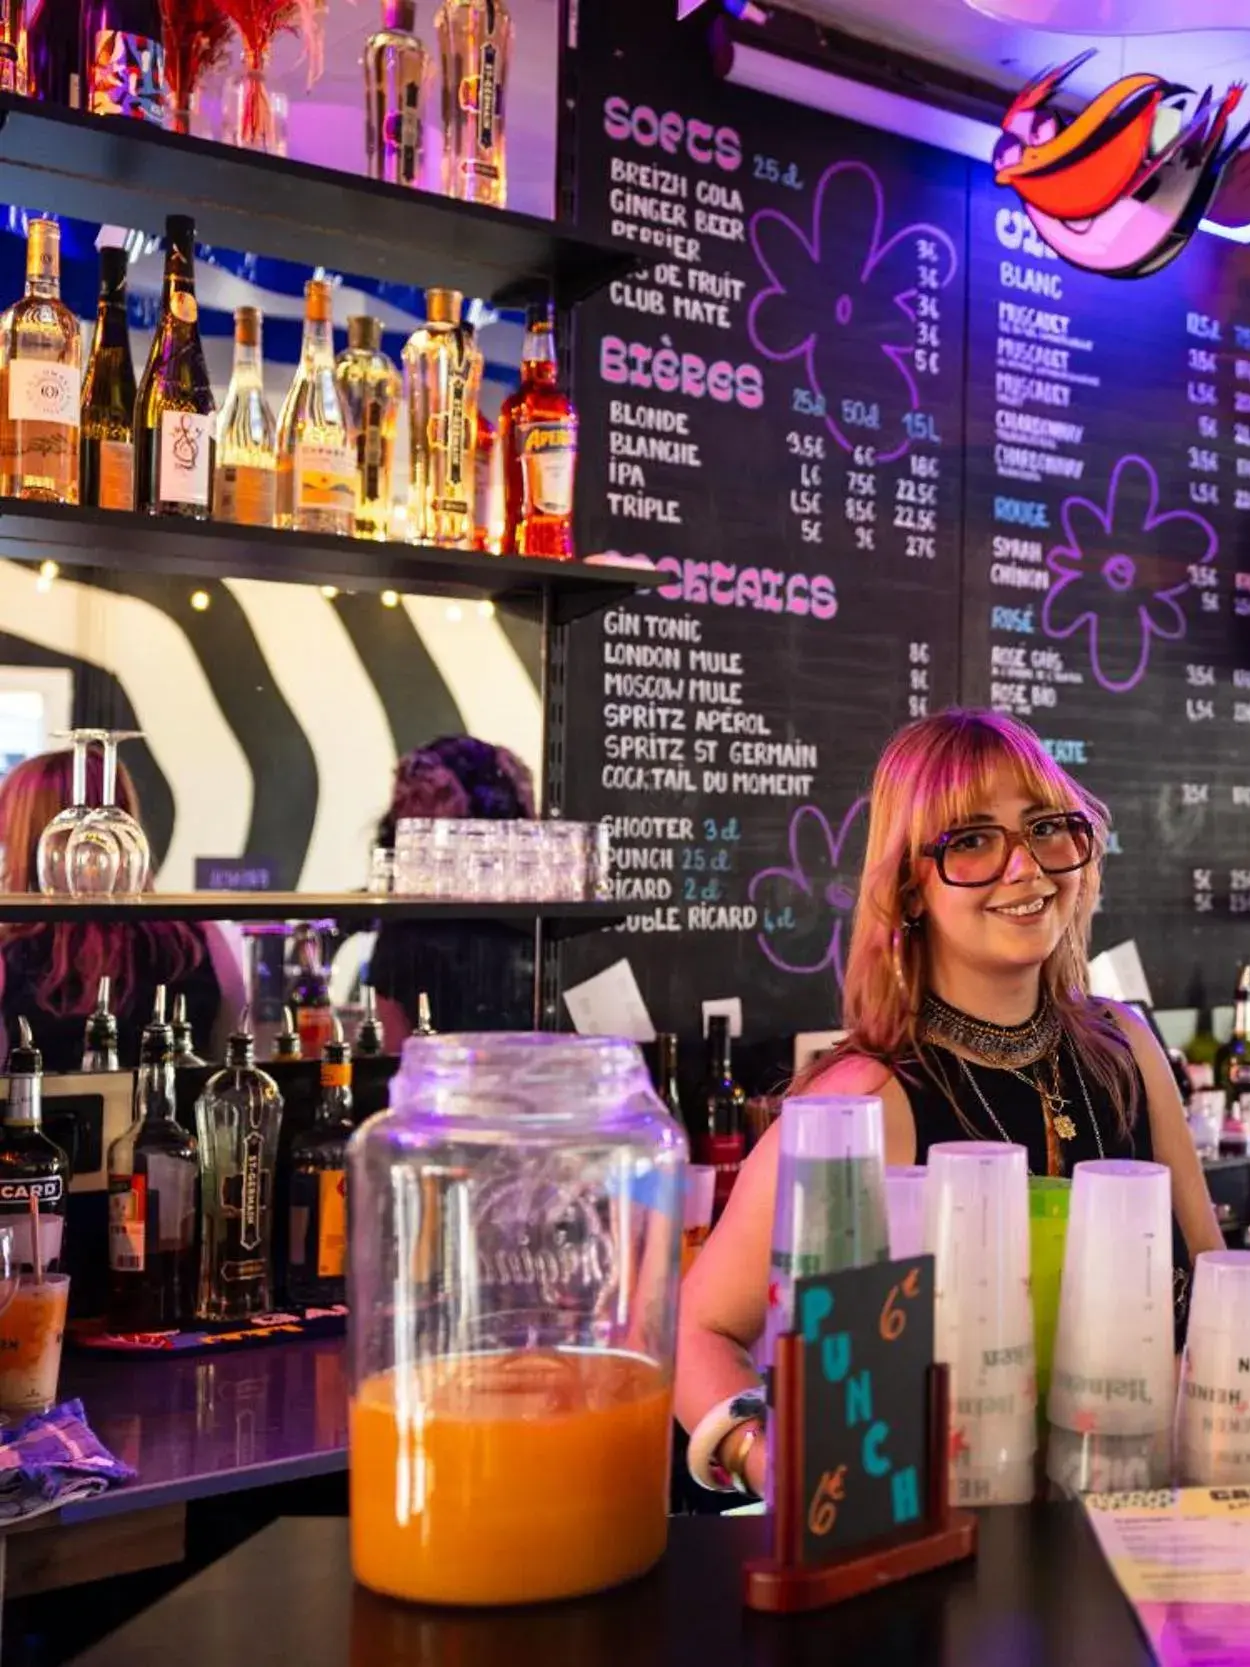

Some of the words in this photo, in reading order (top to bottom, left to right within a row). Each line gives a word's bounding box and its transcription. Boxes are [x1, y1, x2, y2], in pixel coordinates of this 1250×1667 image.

[604, 96, 742, 172] SOFTS
[611, 156, 688, 199] BREIZH
[695, 179, 744, 214] COLA
[610, 187, 688, 229] GINGER
[694, 209, 746, 243] BEER
[654, 263, 683, 289] DE
[687, 271, 746, 302] FRUIT
[1000, 261, 1063, 301] BLANC
[609, 281, 666, 315] CLUB
[917, 293, 940, 320] 3€
[917, 321, 940, 347] 3€
[600, 334, 764, 409] BIÈRES
[914, 348, 940, 375] 5€
[609, 400, 690, 436] BLONDE
[609, 430, 702, 467] BLANCHE
[608, 456, 646, 487] IPA
[606, 491, 683, 525] TRIPLE
[603, 550, 839, 620] CKTAILS
[604, 606, 640, 637] GIN
[645, 613, 702, 643] TONIC
[604, 642, 681, 671] LONDON
[689, 650, 744, 675] MULE
[604, 672, 684, 700] MOSCOW
[689, 679, 743, 705] MULE
[604, 701, 686, 731] SPRITZ
[695, 706, 772, 736] APÉROL
[604, 733, 685, 761] SPRITZ
[694, 740, 719, 763] ST
[729, 739, 818, 769] GERMAIN
[703, 770, 727, 793] DU
[732, 772, 814, 797] MOMENT
[601, 815, 694, 841] SHOOTER
[607, 848, 674, 871] PUNCH
[602, 906, 683, 933] UBLE
[688, 902, 758, 932] RICARD
[1, 1183, 57, 1200] CARD
[803, 1285, 920, 1523] PUNCH
